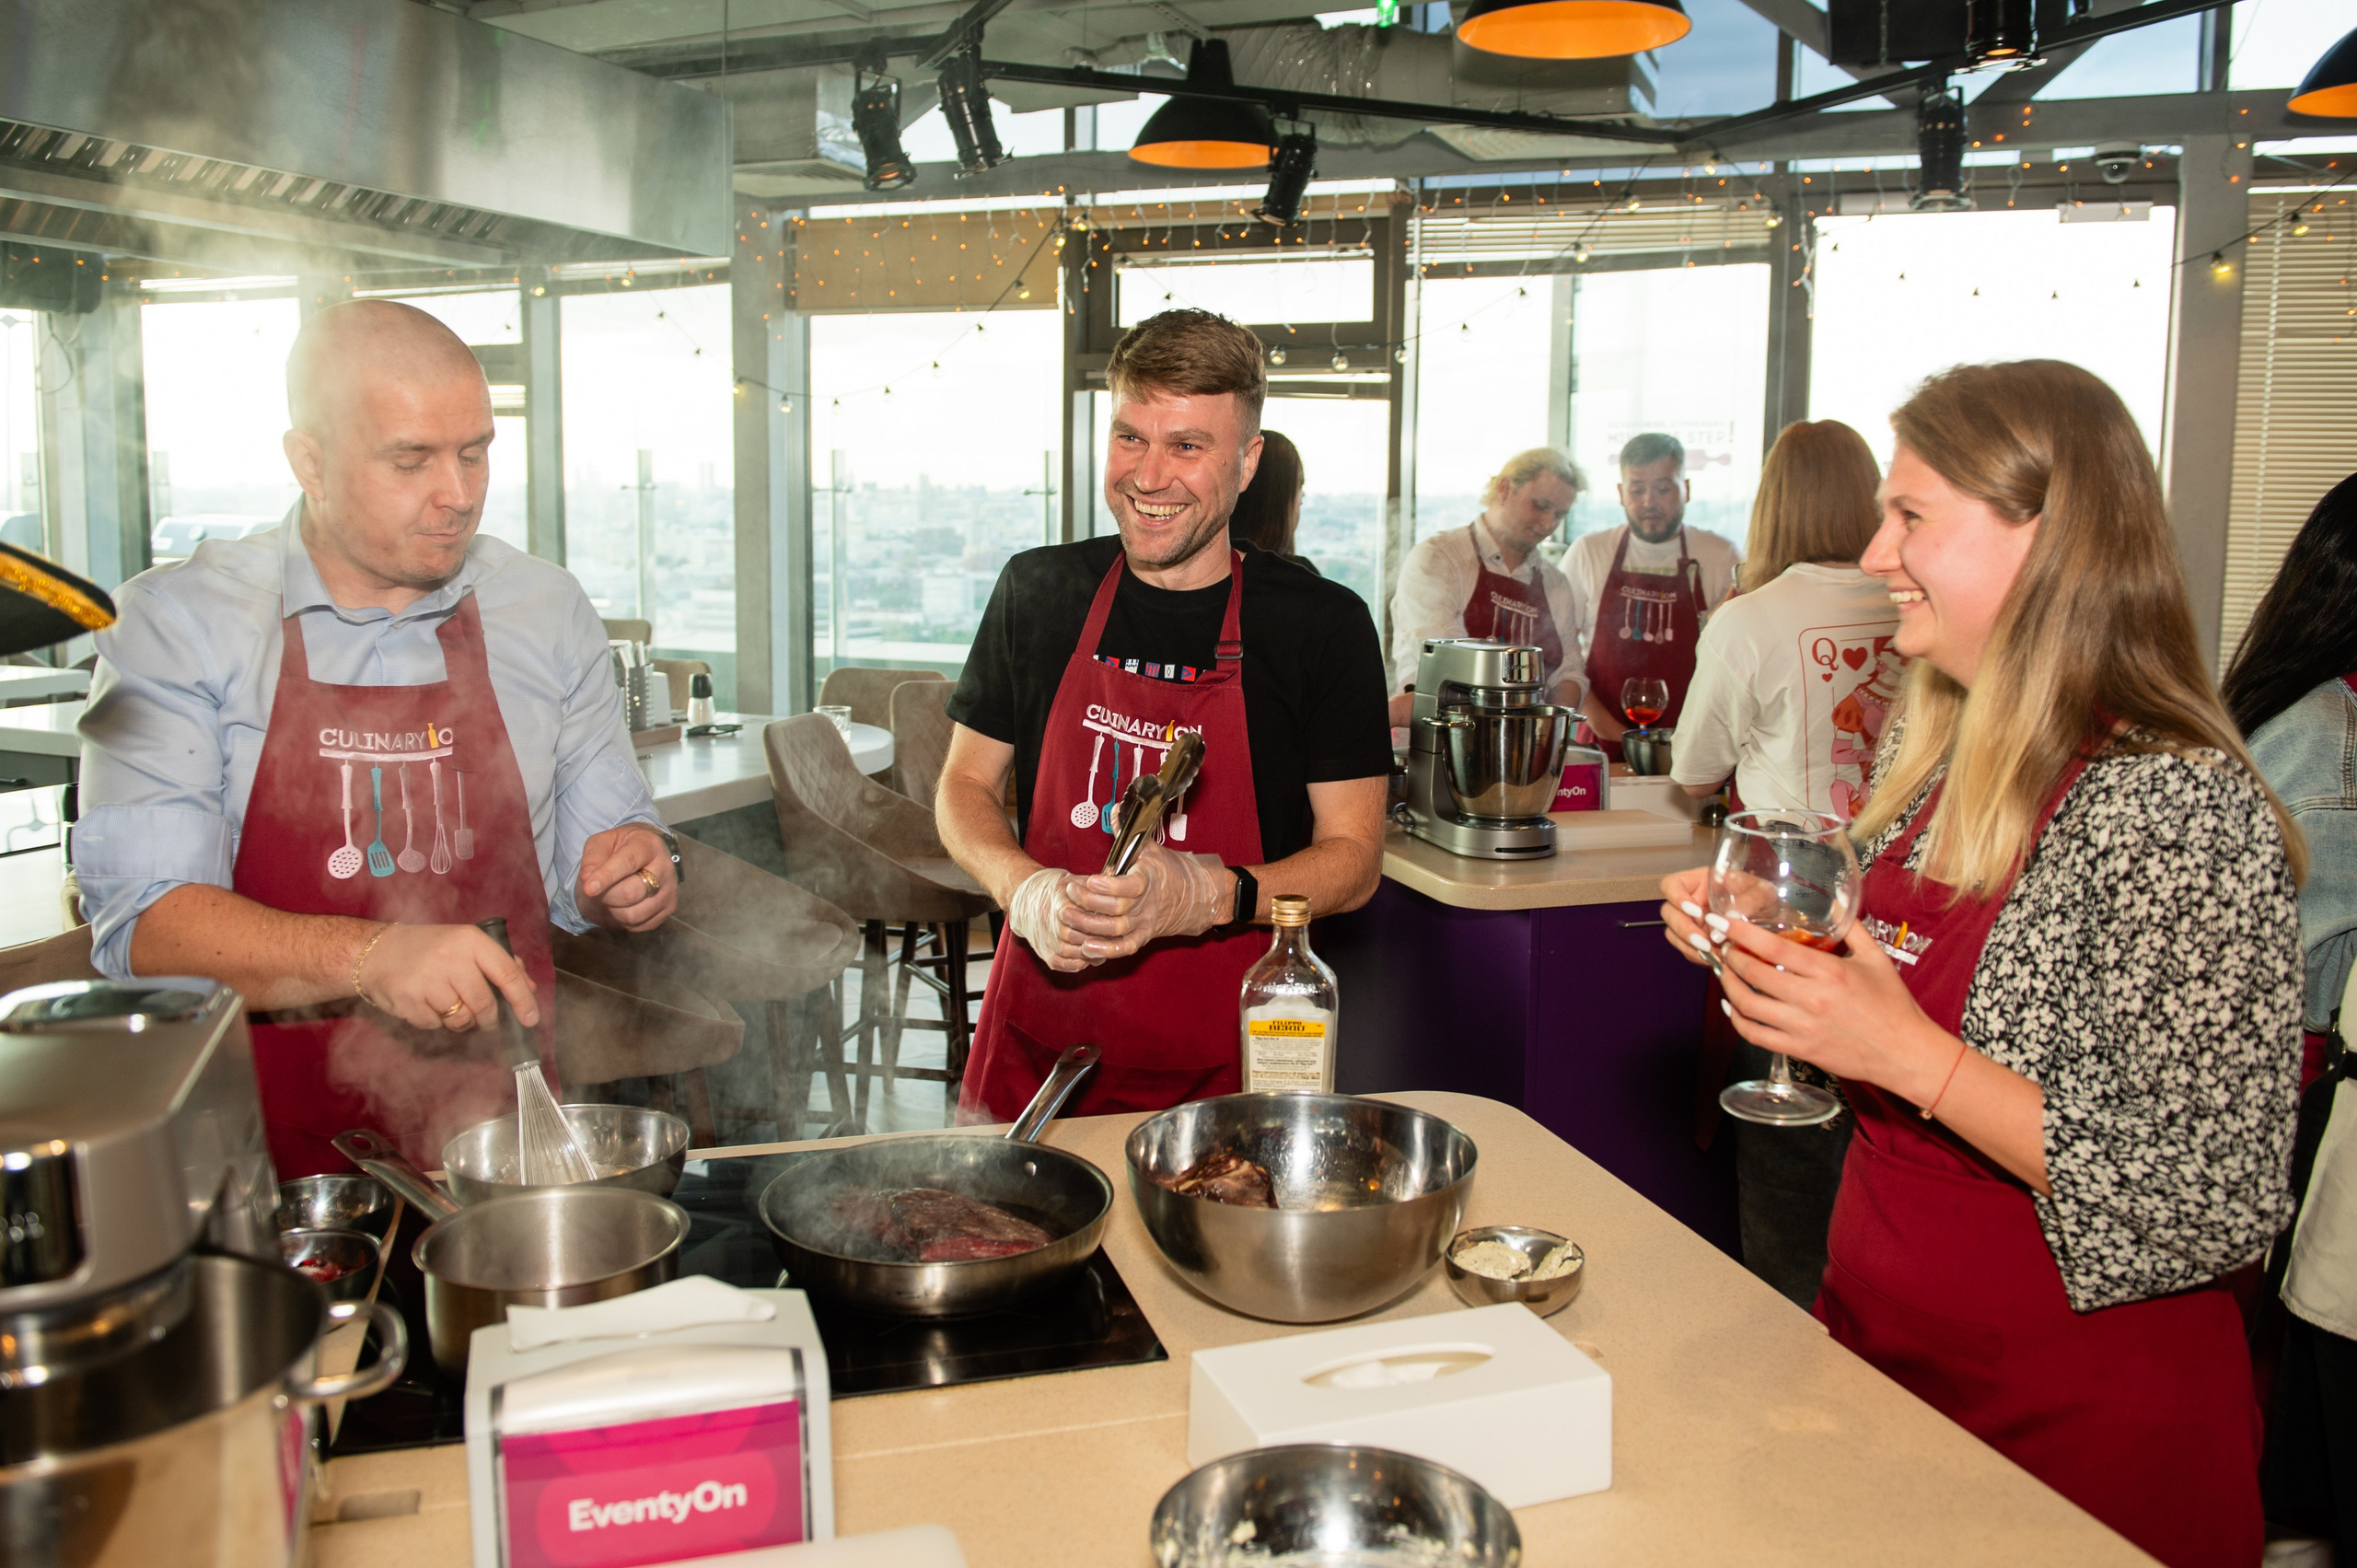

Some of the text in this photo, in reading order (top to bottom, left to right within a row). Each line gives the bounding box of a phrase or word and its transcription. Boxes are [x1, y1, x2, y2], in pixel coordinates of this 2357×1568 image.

[1687, 431, 1725, 444] STEP
[1812, 637, 1839, 671] Q
[1557, 785, 1586, 798] ntyOn
[568, 1480, 748, 1531] EventyOn
